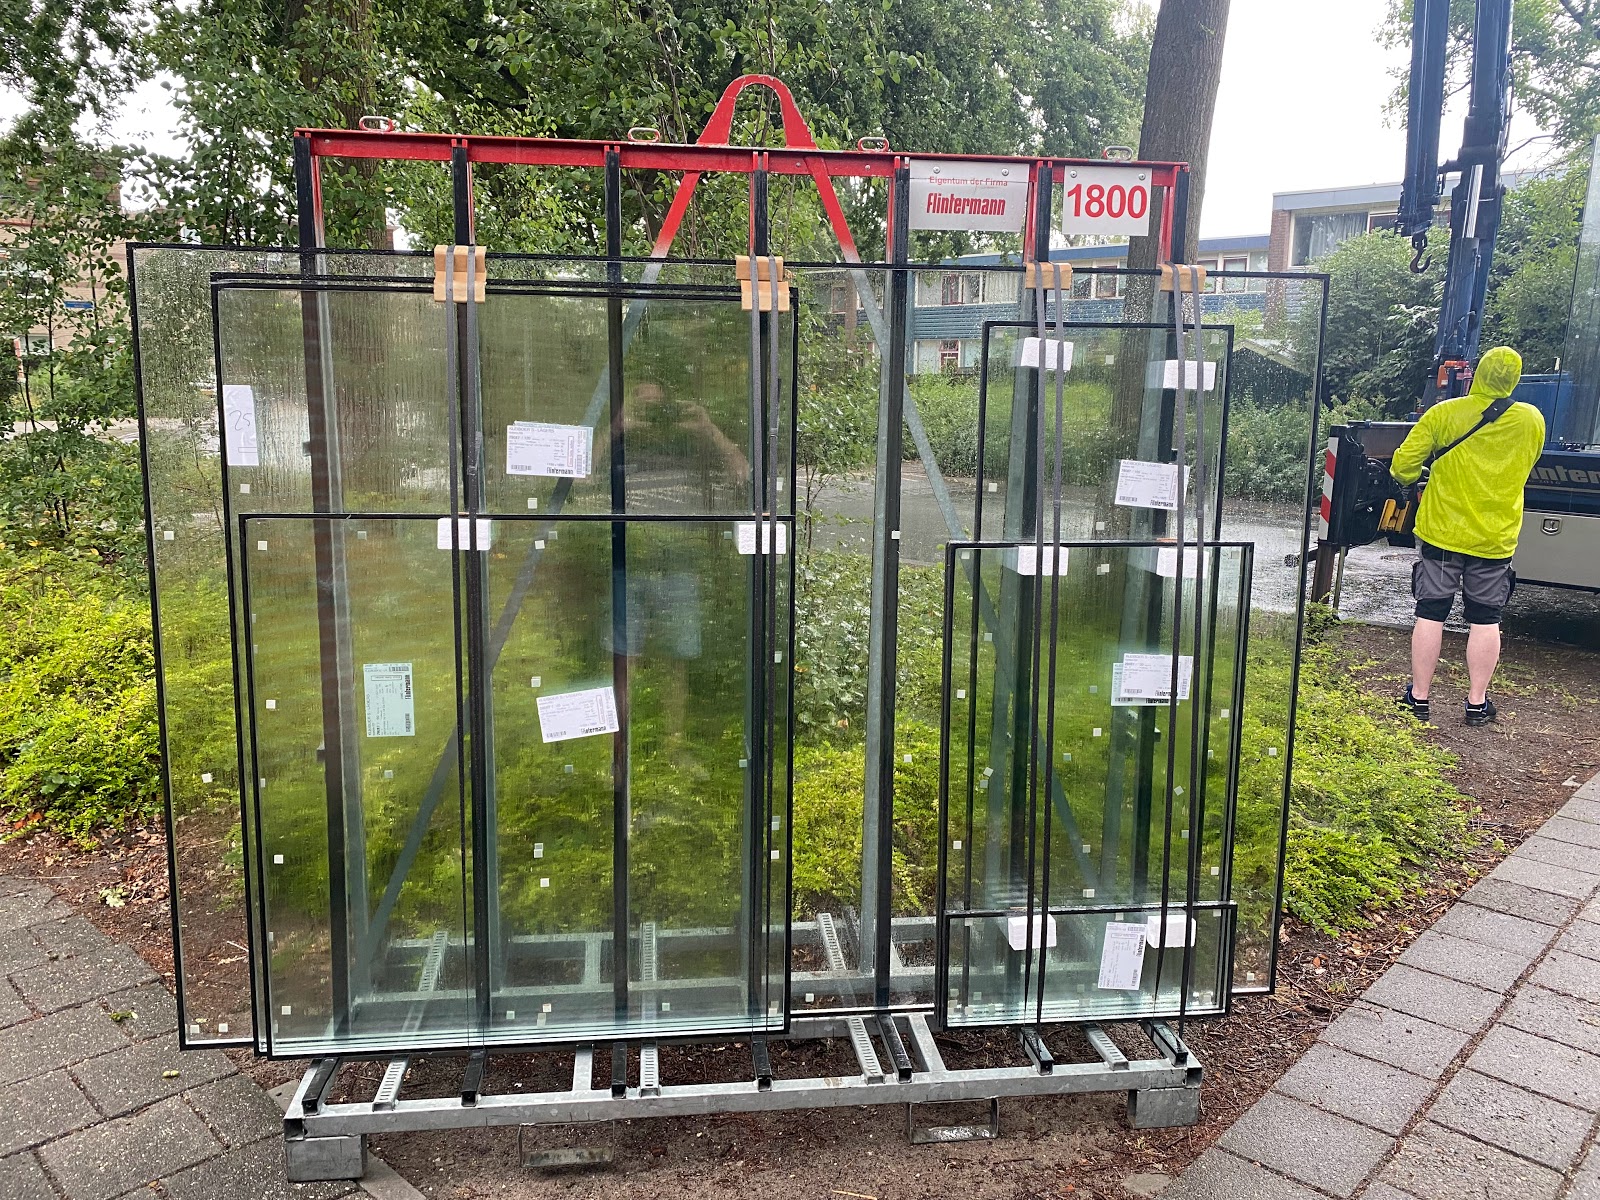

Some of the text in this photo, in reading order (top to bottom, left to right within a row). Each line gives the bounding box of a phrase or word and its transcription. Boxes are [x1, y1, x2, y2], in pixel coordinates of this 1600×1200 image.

[929, 176, 1008, 187] Eigentum der Firma
[926, 192, 1007, 216] Flintermann
[1067, 183, 1148, 219] 1800
[1530, 465, 1600, 484] inter
